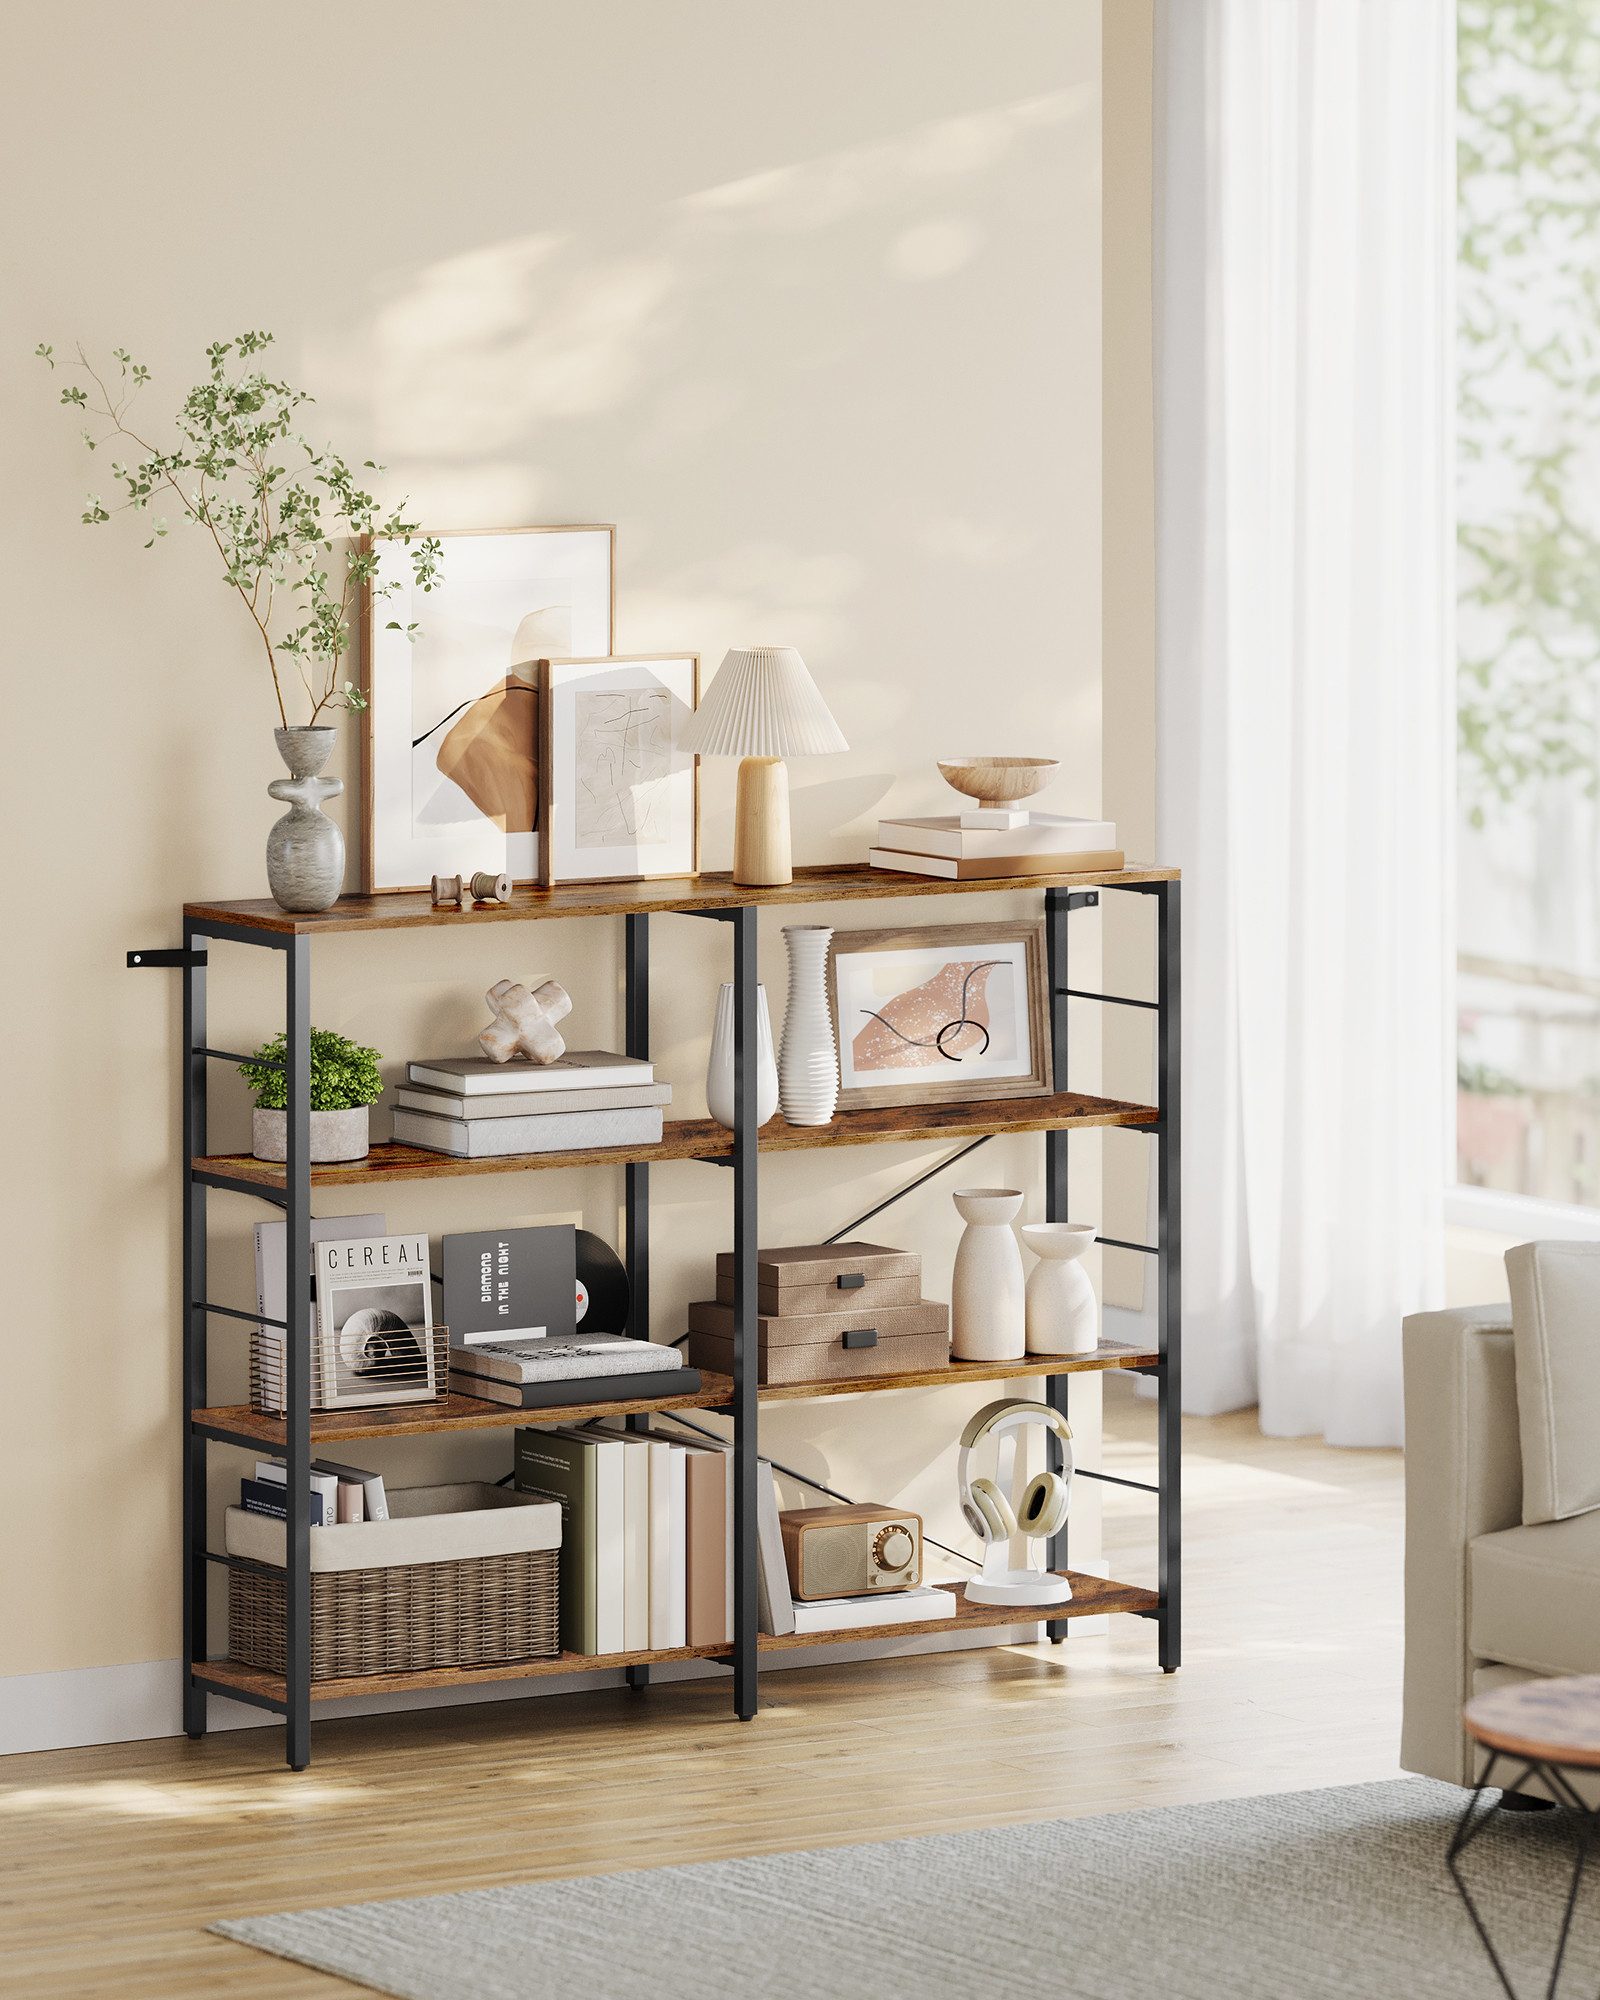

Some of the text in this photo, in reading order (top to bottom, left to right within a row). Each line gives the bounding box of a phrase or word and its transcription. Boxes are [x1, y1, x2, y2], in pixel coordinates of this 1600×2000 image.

[328, 1242, 424, 1269] CEREAL
[480, 1252, 492, 1302] DIAMOND
[498, 1242, 509, 1315] IN THE NIGHT
